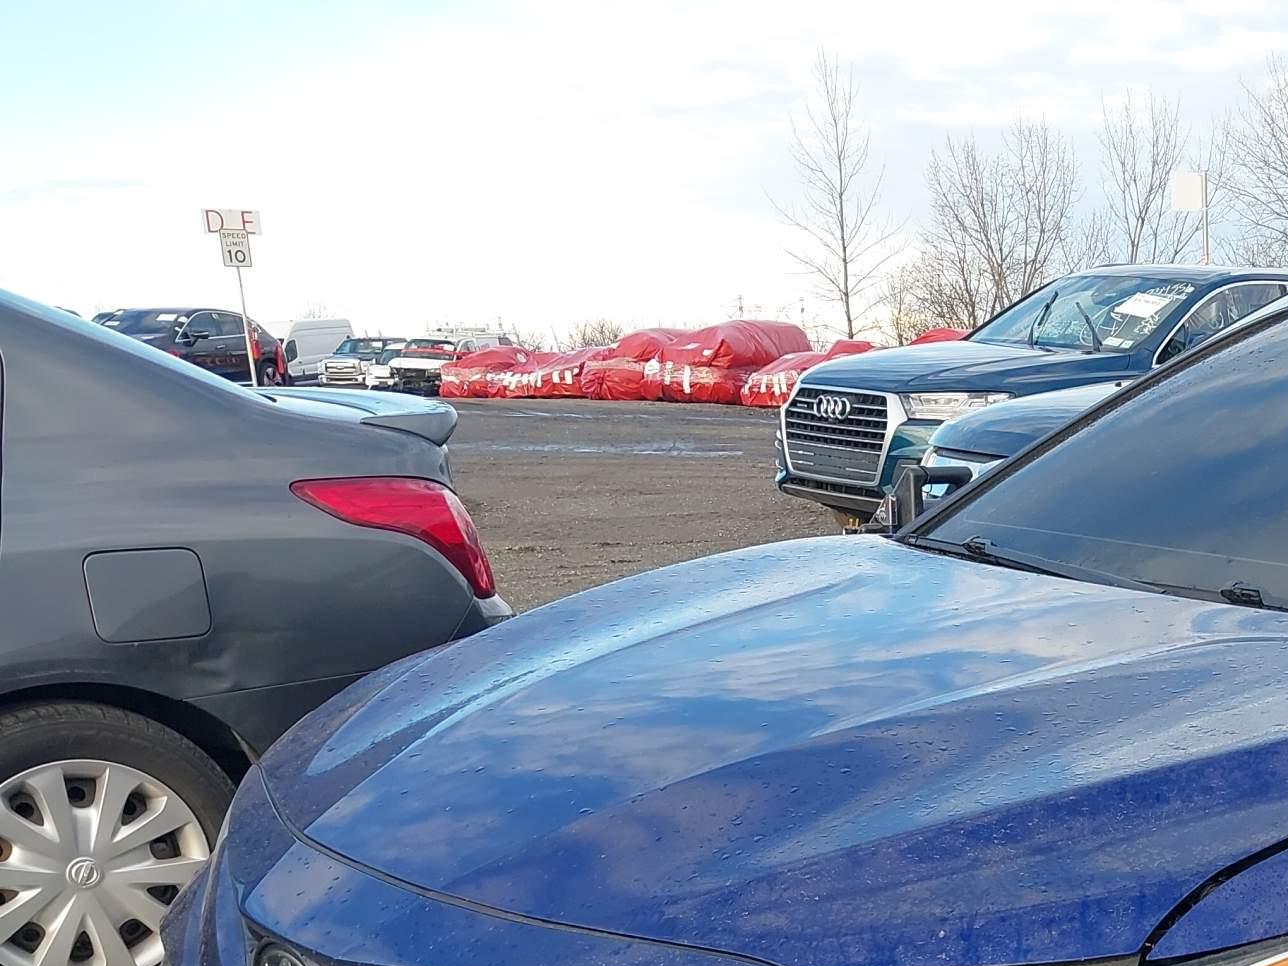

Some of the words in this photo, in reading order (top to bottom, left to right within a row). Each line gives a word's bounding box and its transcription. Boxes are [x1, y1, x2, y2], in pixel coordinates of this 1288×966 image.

[205, 209, 224, 233] D
[241, 210, 256, 235] E
[227, 249, 246, 263] 10
